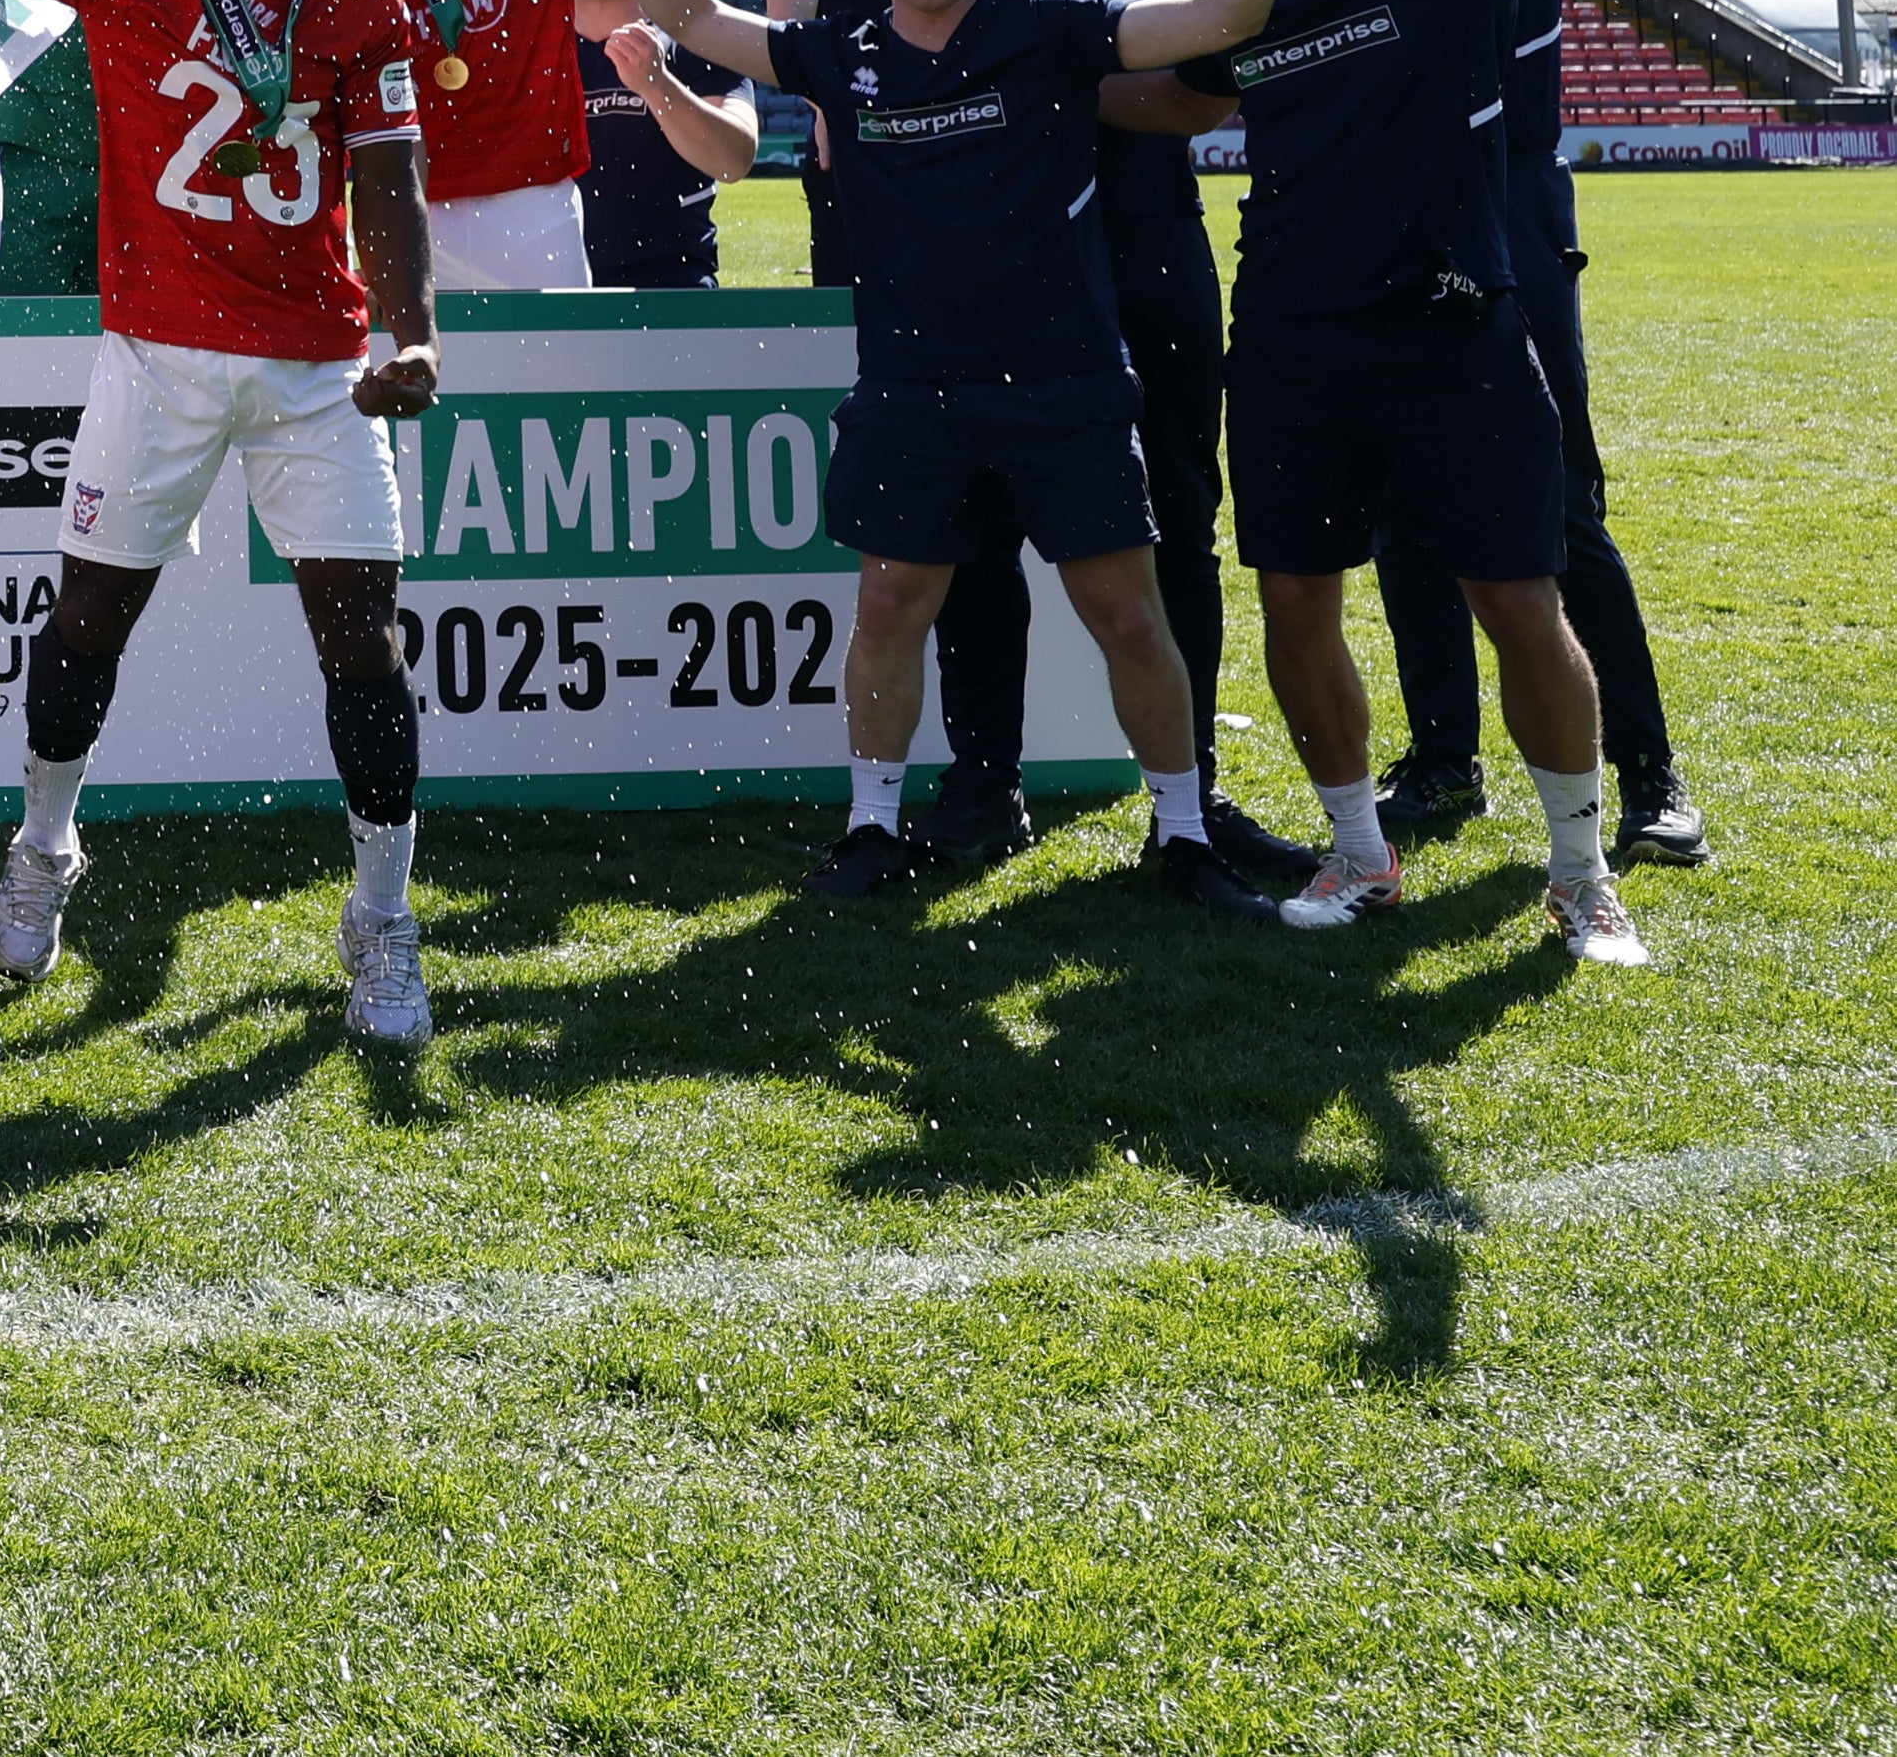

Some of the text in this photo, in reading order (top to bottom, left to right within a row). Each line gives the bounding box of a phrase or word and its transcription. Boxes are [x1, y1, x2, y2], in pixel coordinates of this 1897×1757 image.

[1240, 17, 1391, 78] enterprise
[585, 92, 644, 114] rprise
[866, 102, 1001, 135] enterprise
[1759, 132, 1813, 158] PROUDLY
